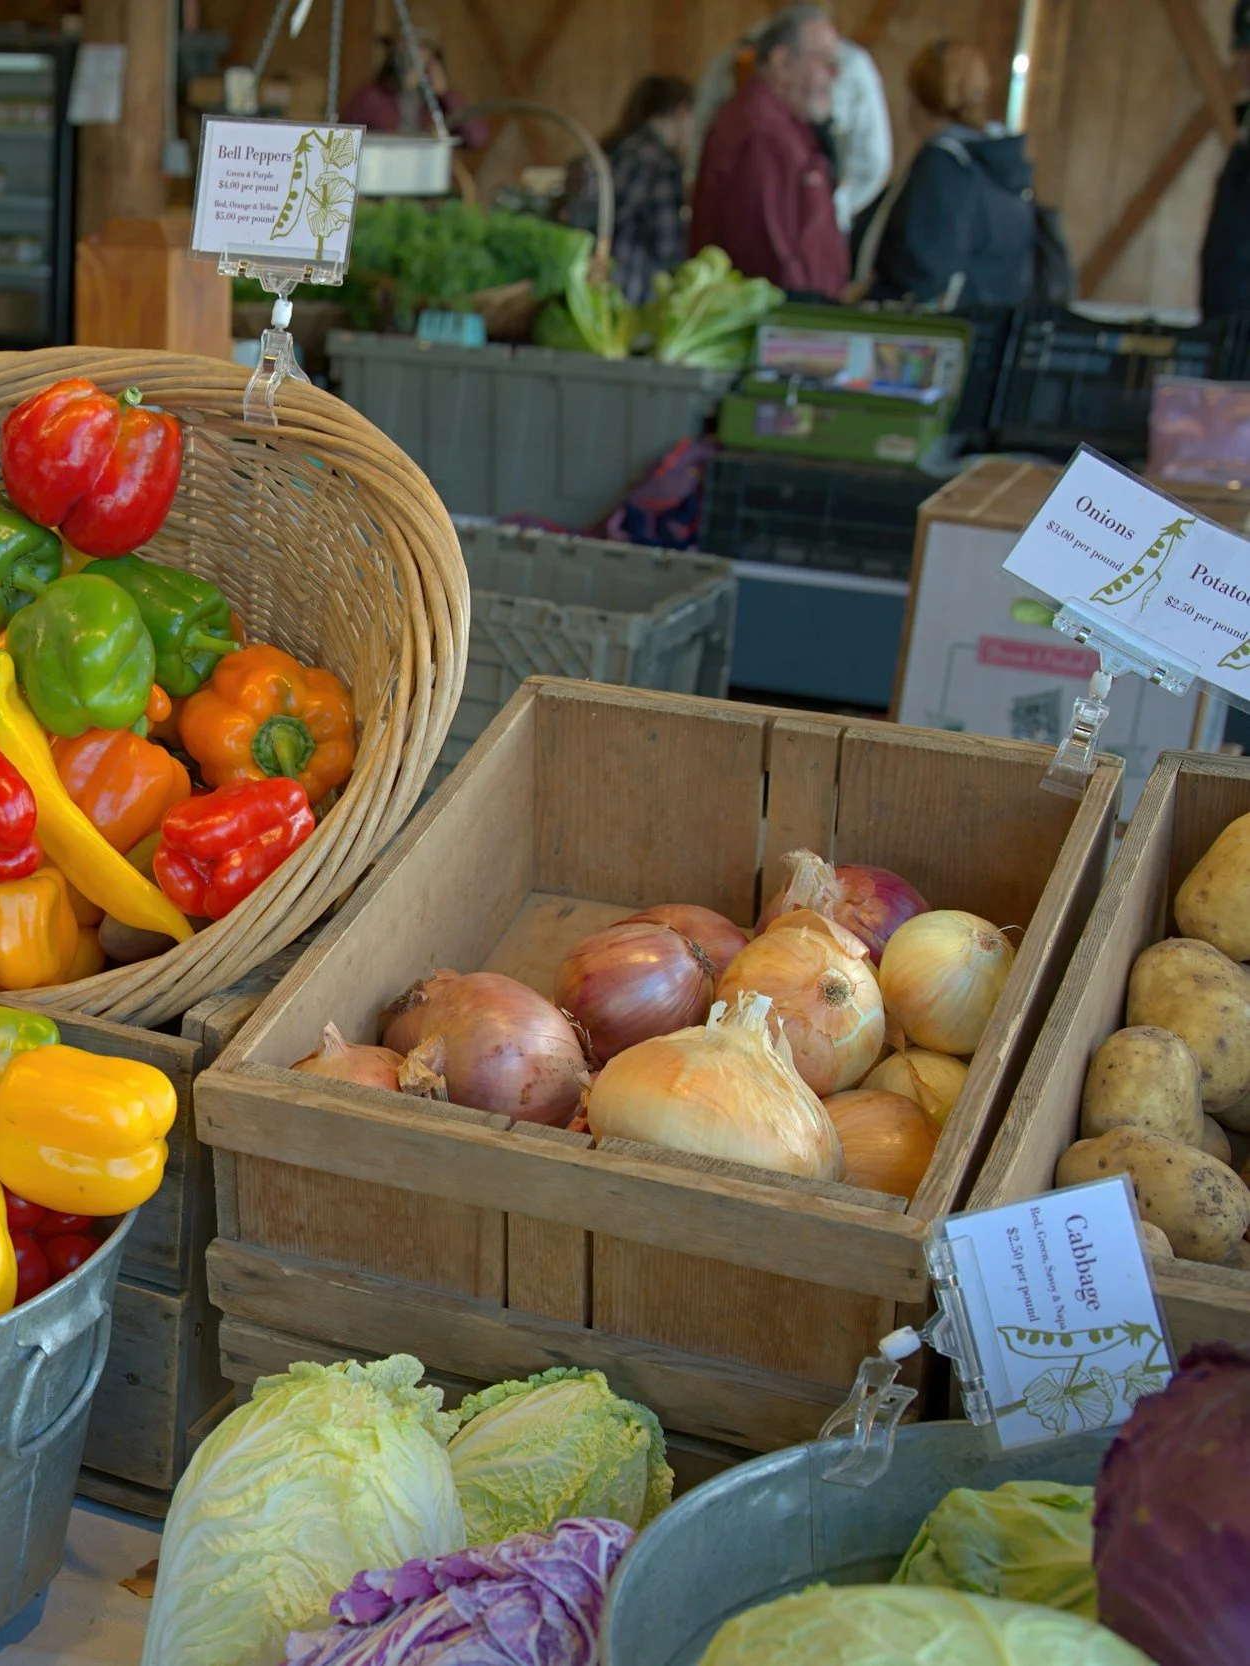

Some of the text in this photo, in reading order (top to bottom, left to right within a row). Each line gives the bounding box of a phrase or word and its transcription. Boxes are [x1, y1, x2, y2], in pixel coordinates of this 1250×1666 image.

[218, 145, 292, 166] Bell Peppers
[227, 169, 245, 178] Green
[253, 170, 274, 181] Purple
[218, 180, 279, 194] $4.00 per pound
[230, 201, 251, 211] Orange
[259, 202, 279, 211] Yellow
[215, 211, 275, 225] $5.00 per pound
[1076, 495, 1135, 541] Onions
[1046, 520, 1124, 572] $3.00 per pound
[1164, 595, 1248, 641] $2.50 per pound
[1006, 1227, 1041, 1323] $2.50 per pound
[1030, 1207, 1043, 1230] Red,
[1045, 1265, 1058, 1293] Savoy
[1054, 1304, 1067, 1330] Napa
[1065, 1214, 1101, 1312] Cabbage
